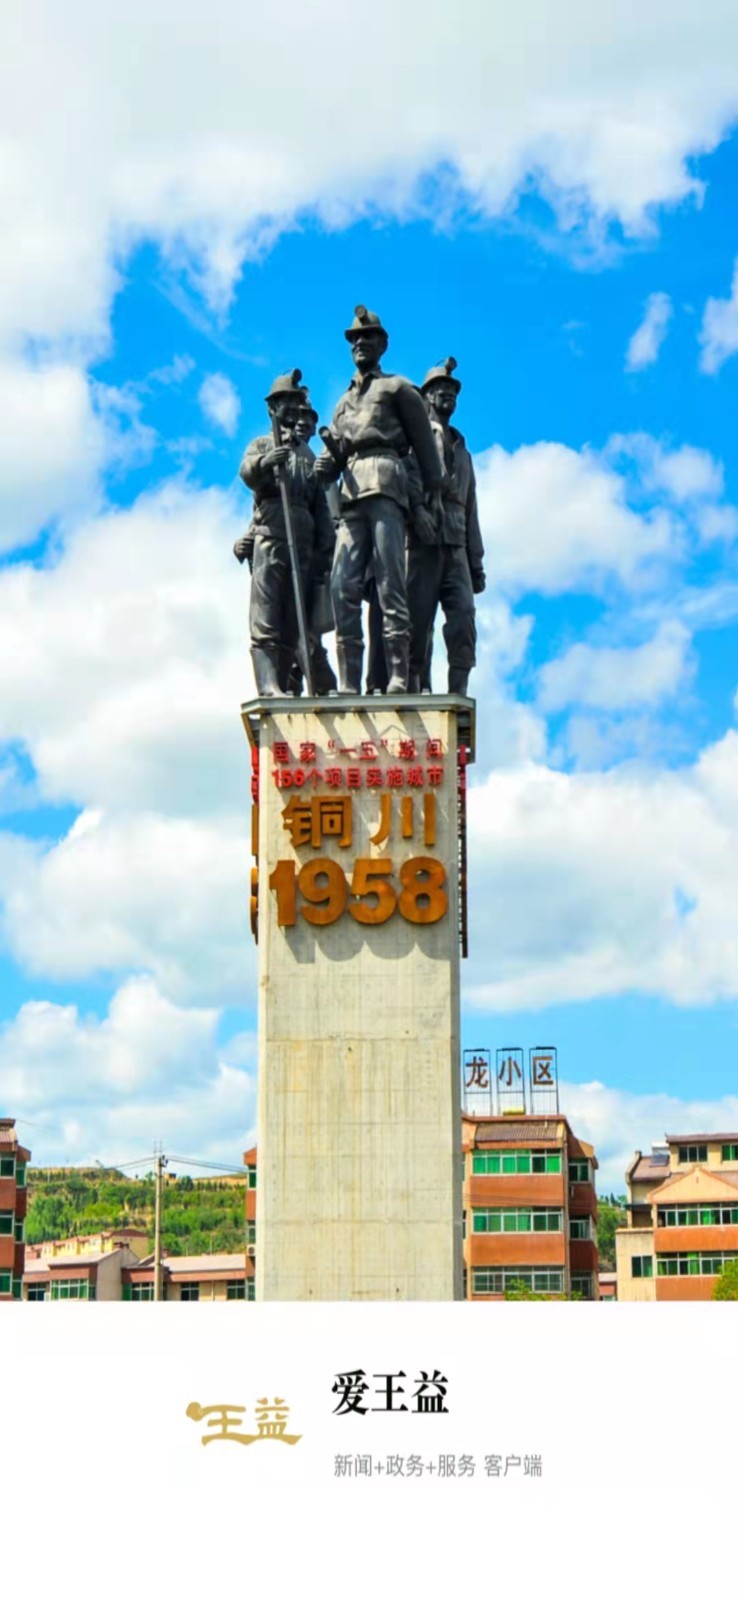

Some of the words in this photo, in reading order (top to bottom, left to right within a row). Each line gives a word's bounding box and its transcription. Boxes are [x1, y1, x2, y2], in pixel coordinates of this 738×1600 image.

[272, 766, 444, 788] 156个项目实施城市
[281, 793, 436, 848] 铜川
[269, 857, 449, 926] 1958
[465, 1056, 554, 1088] 龙小区
